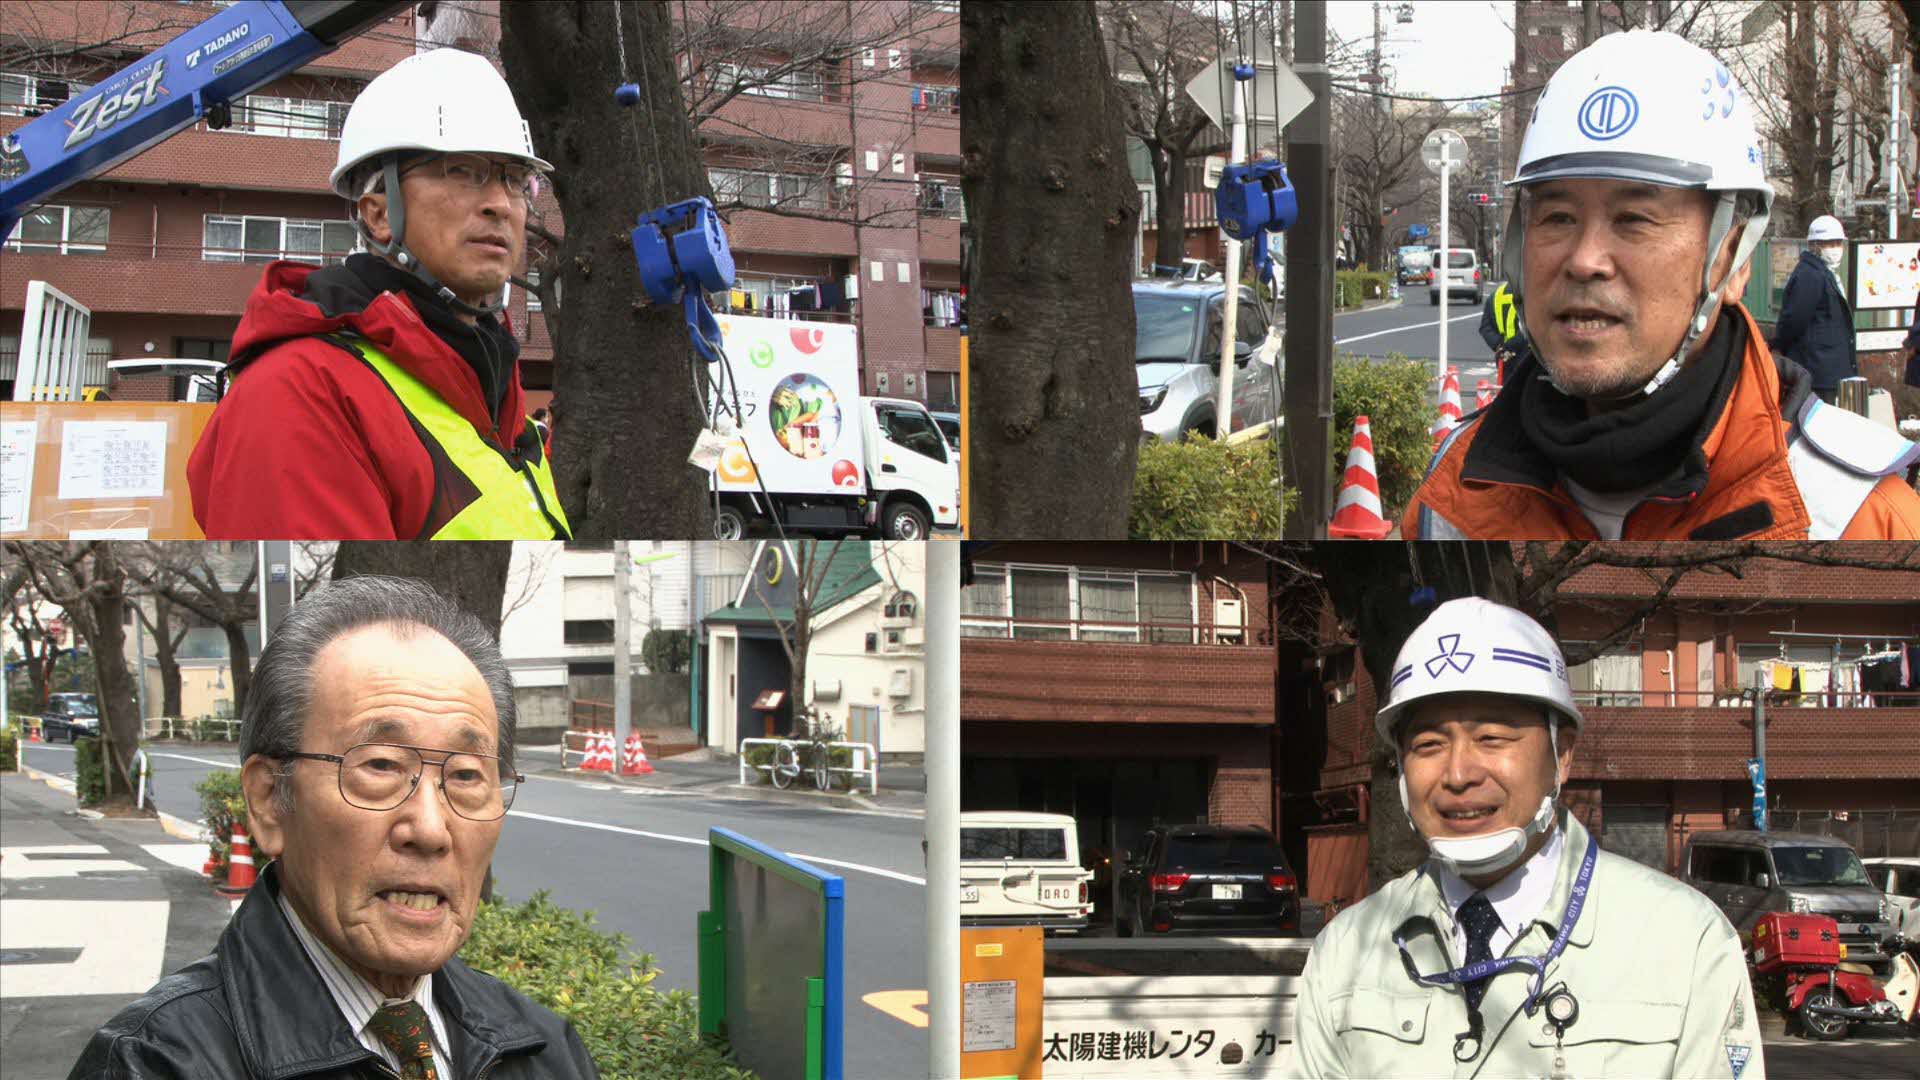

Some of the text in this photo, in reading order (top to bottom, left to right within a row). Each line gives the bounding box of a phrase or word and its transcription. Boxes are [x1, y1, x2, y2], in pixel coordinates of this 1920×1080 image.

[203, 23, 249, 56] TADANO
[64, 58, 164, 149] Zest
[1568, 899, 1580, 919] CITY
